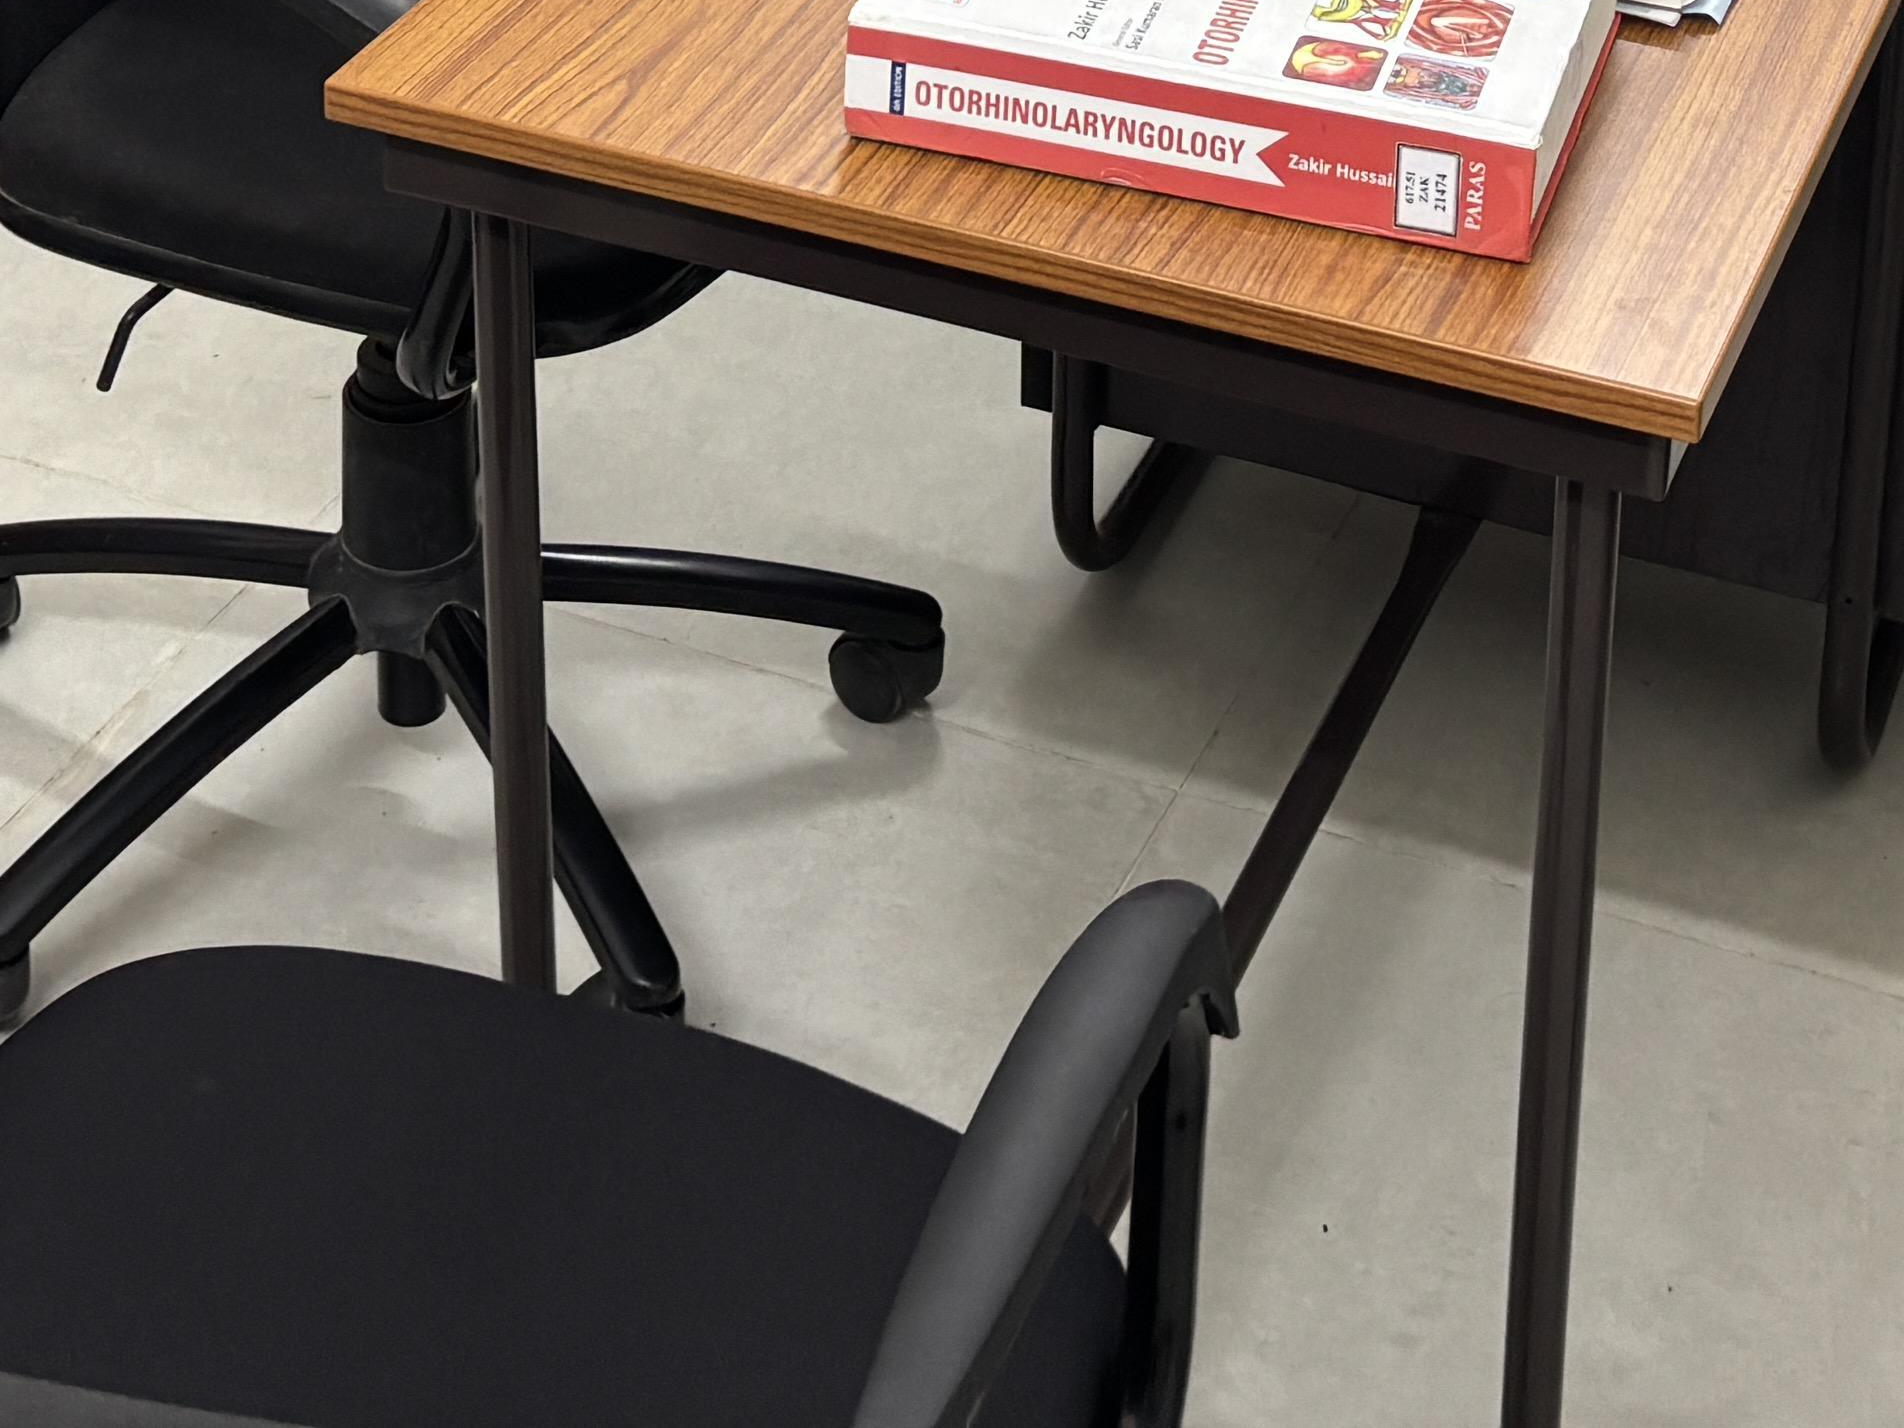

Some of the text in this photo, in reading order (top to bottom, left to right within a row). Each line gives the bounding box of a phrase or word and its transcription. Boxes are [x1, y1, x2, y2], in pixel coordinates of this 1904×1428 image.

[1067, 0, 1097, 42] Zakir
[914, 78, 1393, 190] OTORHINOLARYNGOLOGY Zakir Hussai
[1418, 175, 1431, 204] ZAK
[1434, 173, 1449, 214] 21474
[1463, 160, 1487, 232] PARAS
